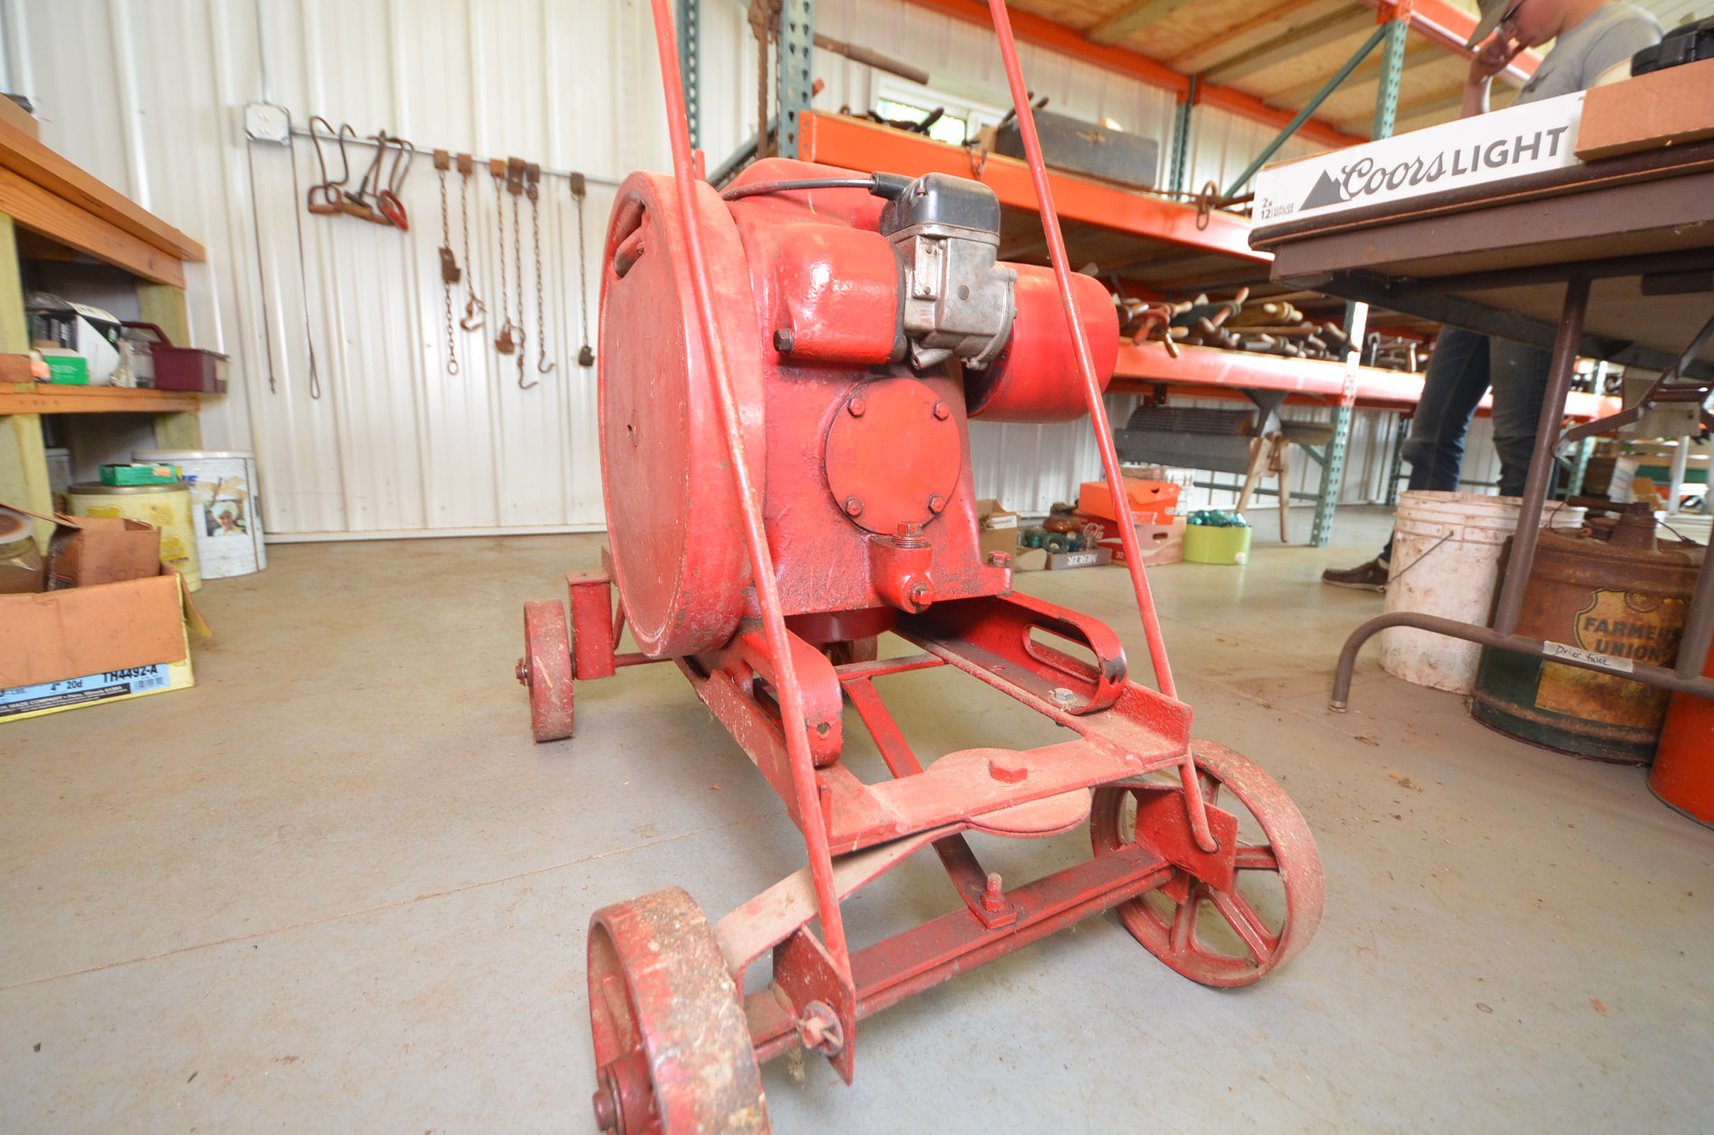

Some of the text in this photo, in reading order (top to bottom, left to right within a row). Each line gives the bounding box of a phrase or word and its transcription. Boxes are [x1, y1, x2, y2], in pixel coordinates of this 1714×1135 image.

[1342, 126, 1568, 200] Coors LIGHT
[1596, 639, 1662, 660] UNION
